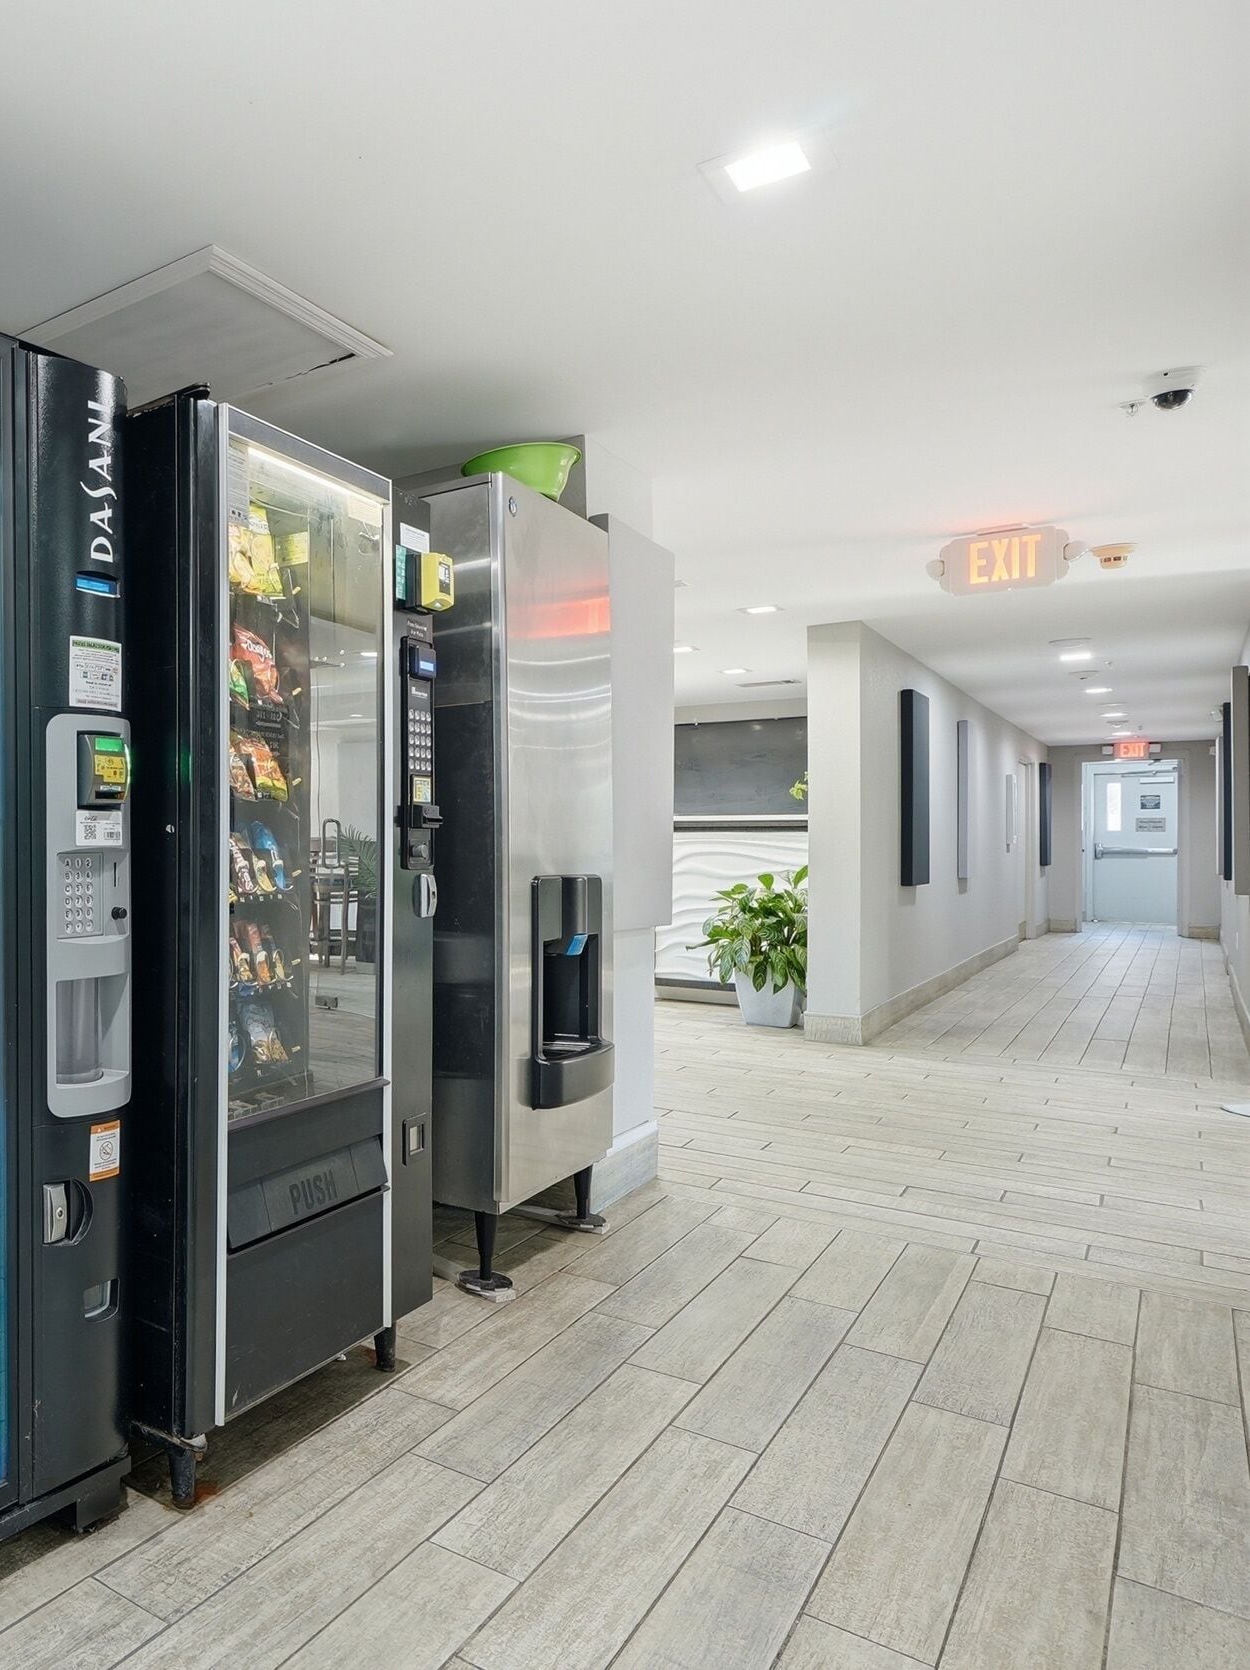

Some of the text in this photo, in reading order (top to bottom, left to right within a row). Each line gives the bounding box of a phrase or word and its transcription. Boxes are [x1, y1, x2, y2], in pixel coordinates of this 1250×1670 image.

[80, 400, 118, 563] DASANI
[969, 534, 1041, 584] EXIT
[1121, 743, 1146, 758] EXIT
[289, 1168, 338, 1216] PUSH
